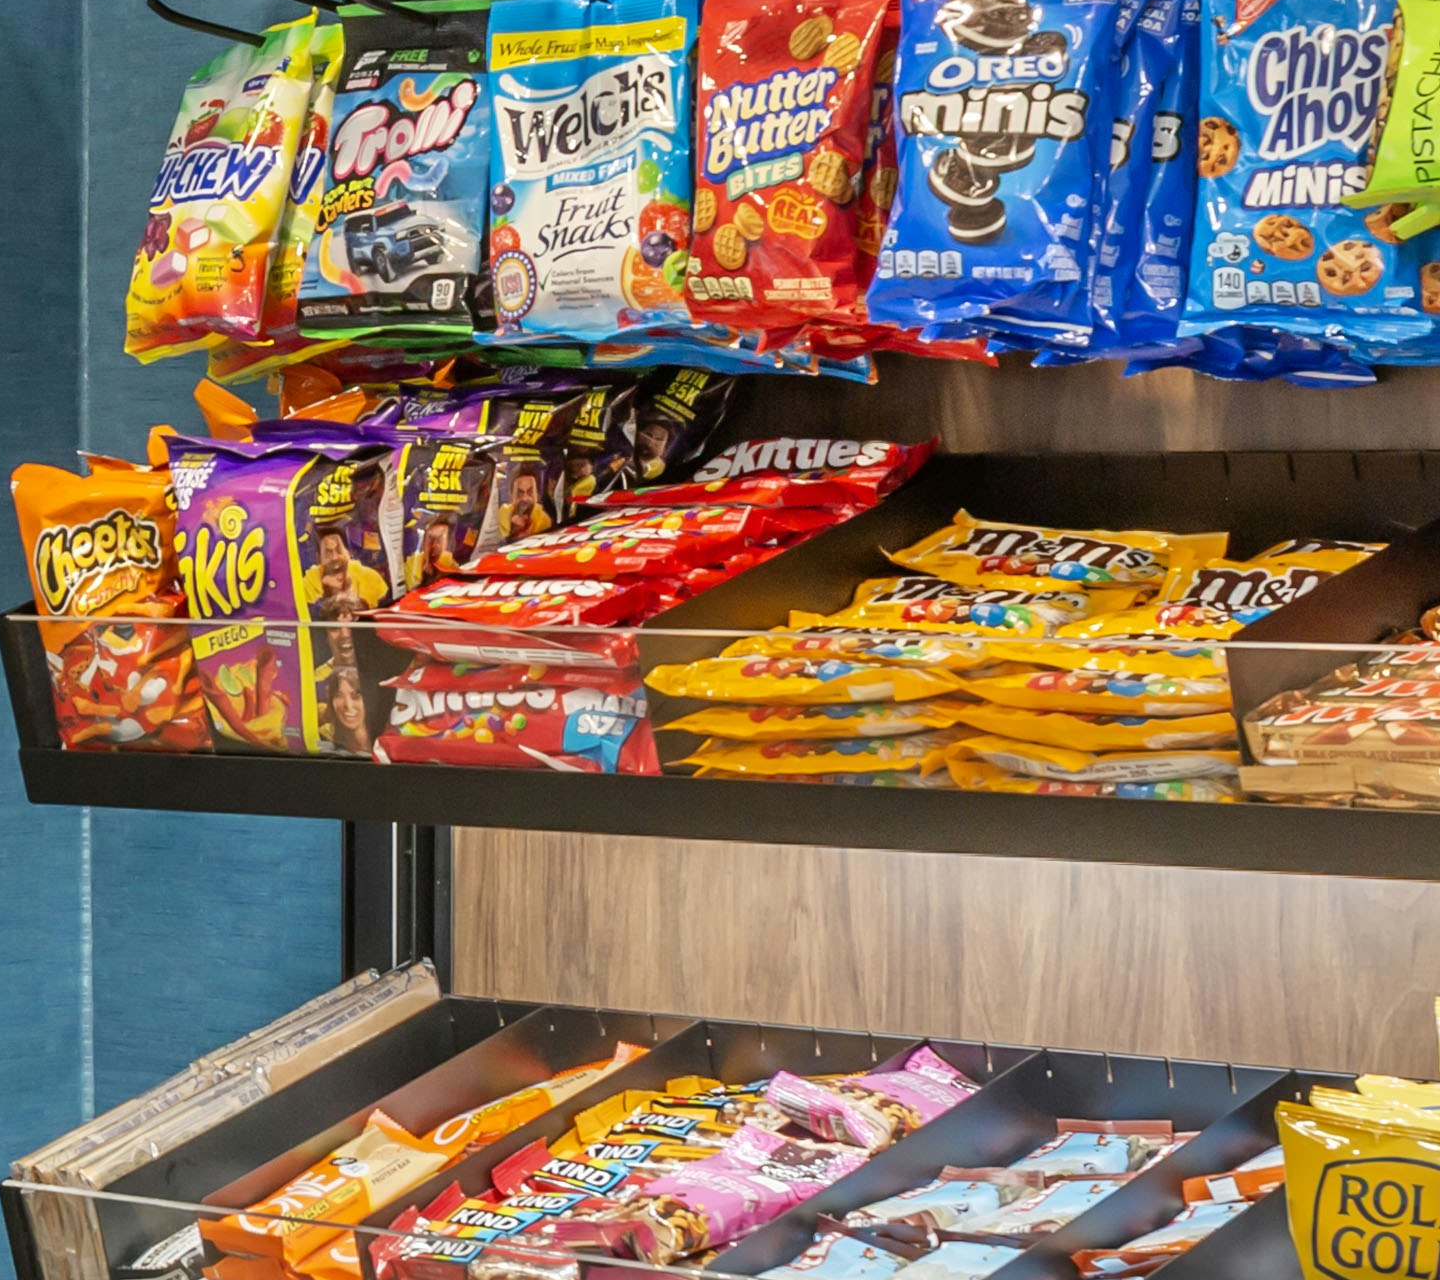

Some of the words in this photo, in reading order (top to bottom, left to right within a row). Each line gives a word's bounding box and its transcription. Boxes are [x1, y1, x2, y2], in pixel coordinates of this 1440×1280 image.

[390, 49, 428, 63] FREE
[500, 40, 543, 57] Whole
[1253, 24, 1389, 101] Chips
[928, 54, 1068, 89] OREO
[711, 68, 837, 123] Nutter
[901, 82, 1088, 140] minis
[334, 79, 476, 179] Trolli
[503, 64, 667, 164] Welch's
[1266, 76, 1384, 154] Ahoy
[706, 108, 834, 176] Butter
[552, 166, 596, 187] MIXED
[727, 155, 804, 198] BITES
[555, 186, 627, 227] Fruit
[533, 215, 634, 258] Snacks
[436, 282, 450, 297] 90
[1216, 272, 1243, 291] 140
[673, 369, 711, 389] WIN
[431, 452, 467, 470] WIN
[694, 437, 894, 483] Skittles
[317, 482, 353, 504] $5K
[427, 470, 462, 491] $5K
[39, 514, 158, 613] Cheetos
[209, 627, 248, 648] FUEGO
[541, 1159, 613, 1187] KIND
[504, 1194, 571, 1209] KIND
[451, 1208, 521, 1231] KIND
